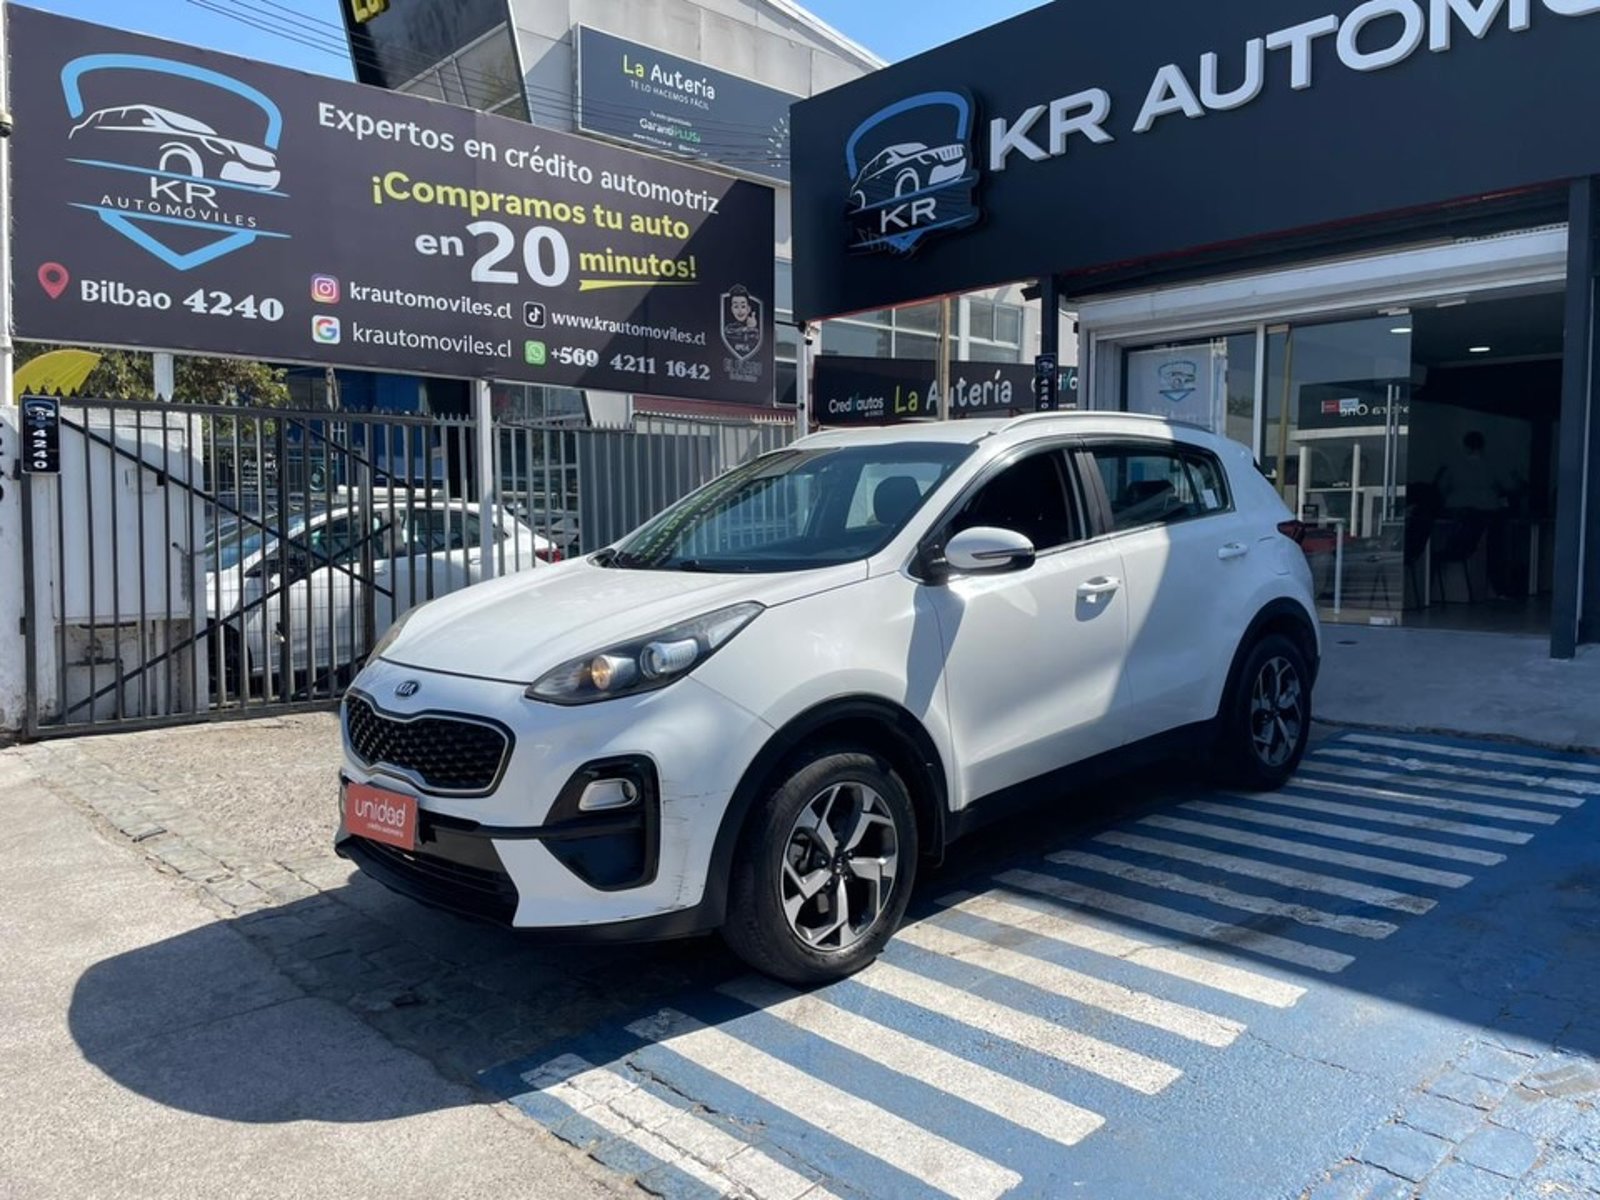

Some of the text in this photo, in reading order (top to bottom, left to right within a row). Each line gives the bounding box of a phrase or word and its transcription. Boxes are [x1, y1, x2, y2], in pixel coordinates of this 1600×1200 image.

[622, 54, 716, 100] La Autería
[990, 87, 1114, 172] KR
[318, 101, 720, 215] Expertos en crédito automotriz
[101, 194, 257, 227] AUTOMÓVILES
[151, 176, 219, 208] KR
[372, 171, 690, 240] ¡Compramos tu auto
[880, 197, 937, 233] KR
[415, 220, 697, 288] en 20 minutos!
[81, 279, 284, 322] Bilbao 4240
[350, 281, 513, 320] krautomoviles.cl
[352, 321, 512, 358] krautomoviles.cl
[551, 310, 706, 346] www.krautomoviles.cl
[551, 346, 599, 368] +569
[609, 352, 657, 375] 4211
[665, 359, 711, 380] 1642
[894, 385, 919, 413] La
[32, 429, 48, 469] 4240
[355, 799, 406, 827] unidad
